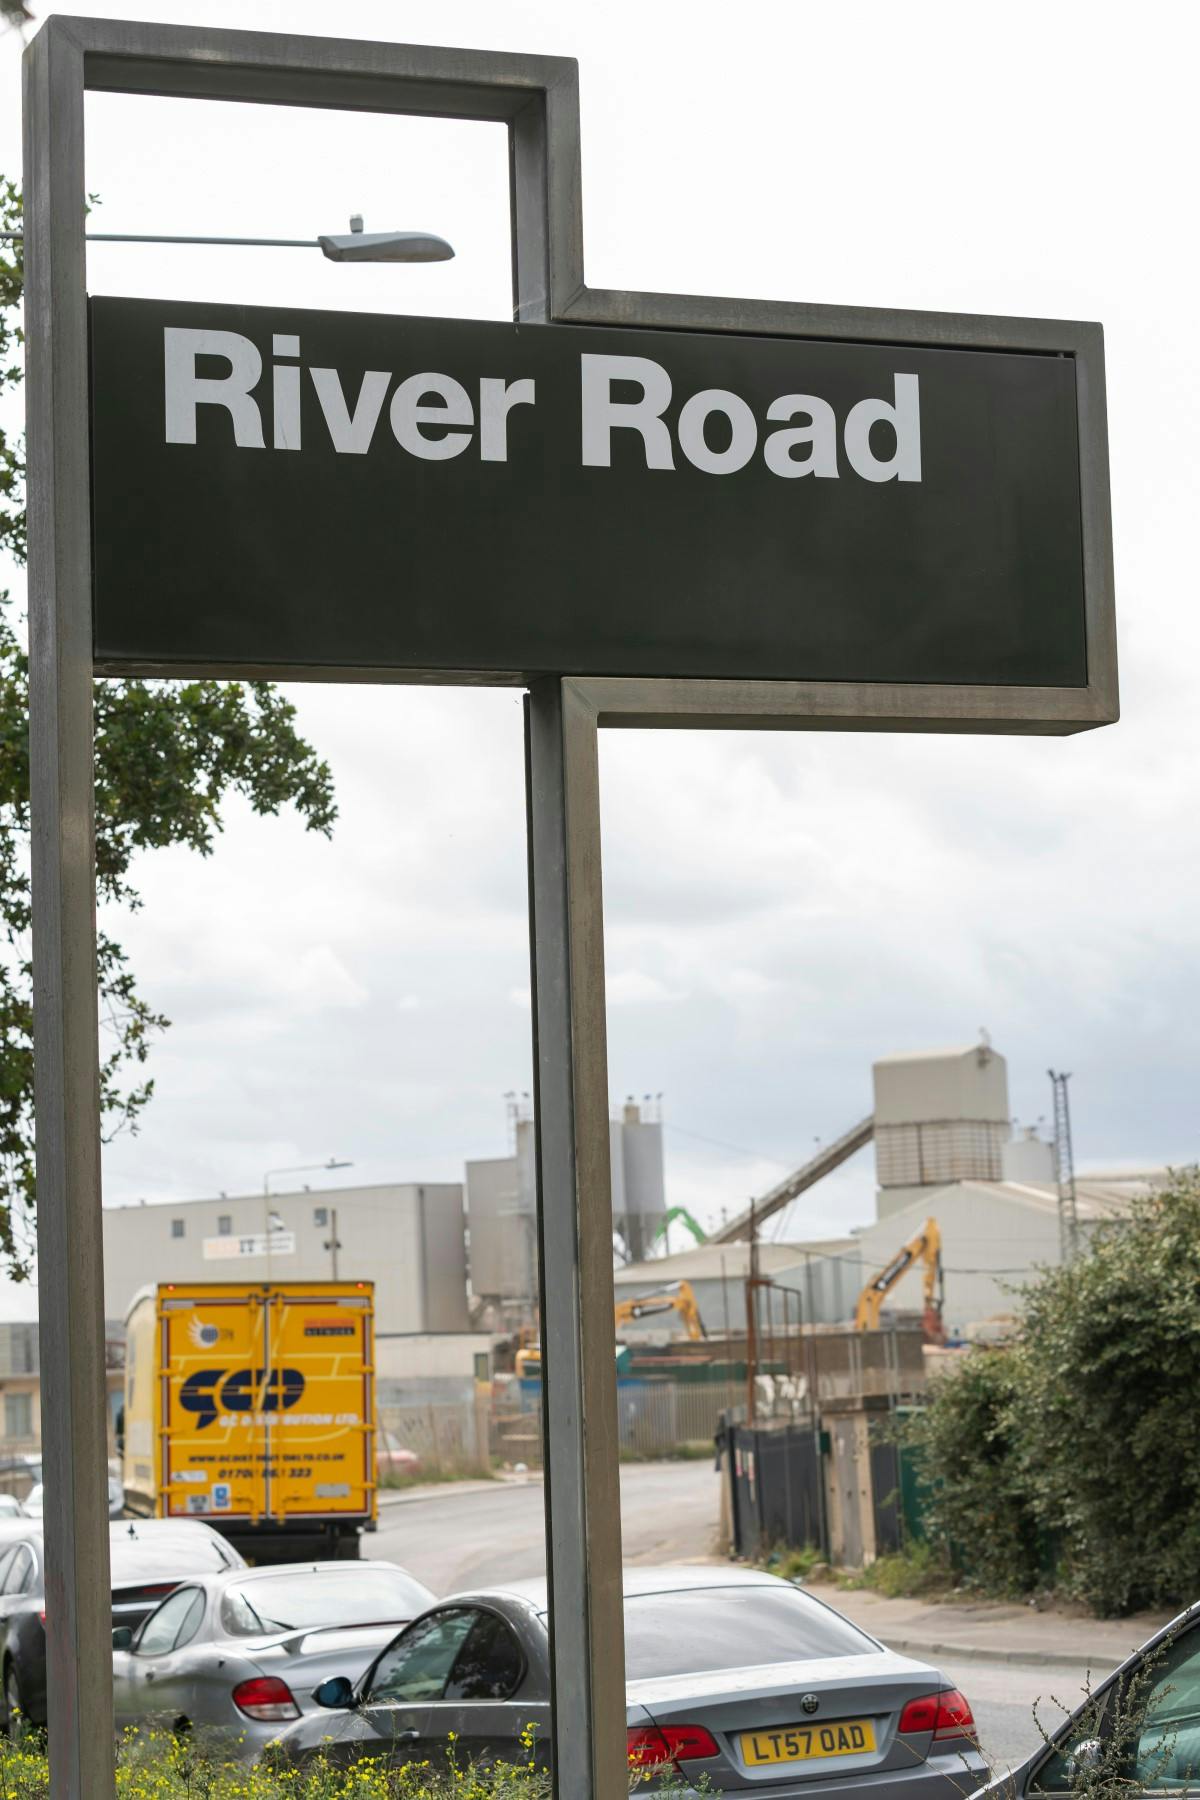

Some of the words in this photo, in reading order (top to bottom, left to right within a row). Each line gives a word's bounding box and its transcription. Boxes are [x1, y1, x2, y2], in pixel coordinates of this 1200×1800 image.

[163, 327, 537, 463] River
[580, 353, 923, 483] Road
[752, 1731, 812, 1760] LT57
[819, 1725, 865, 1752] OAD
